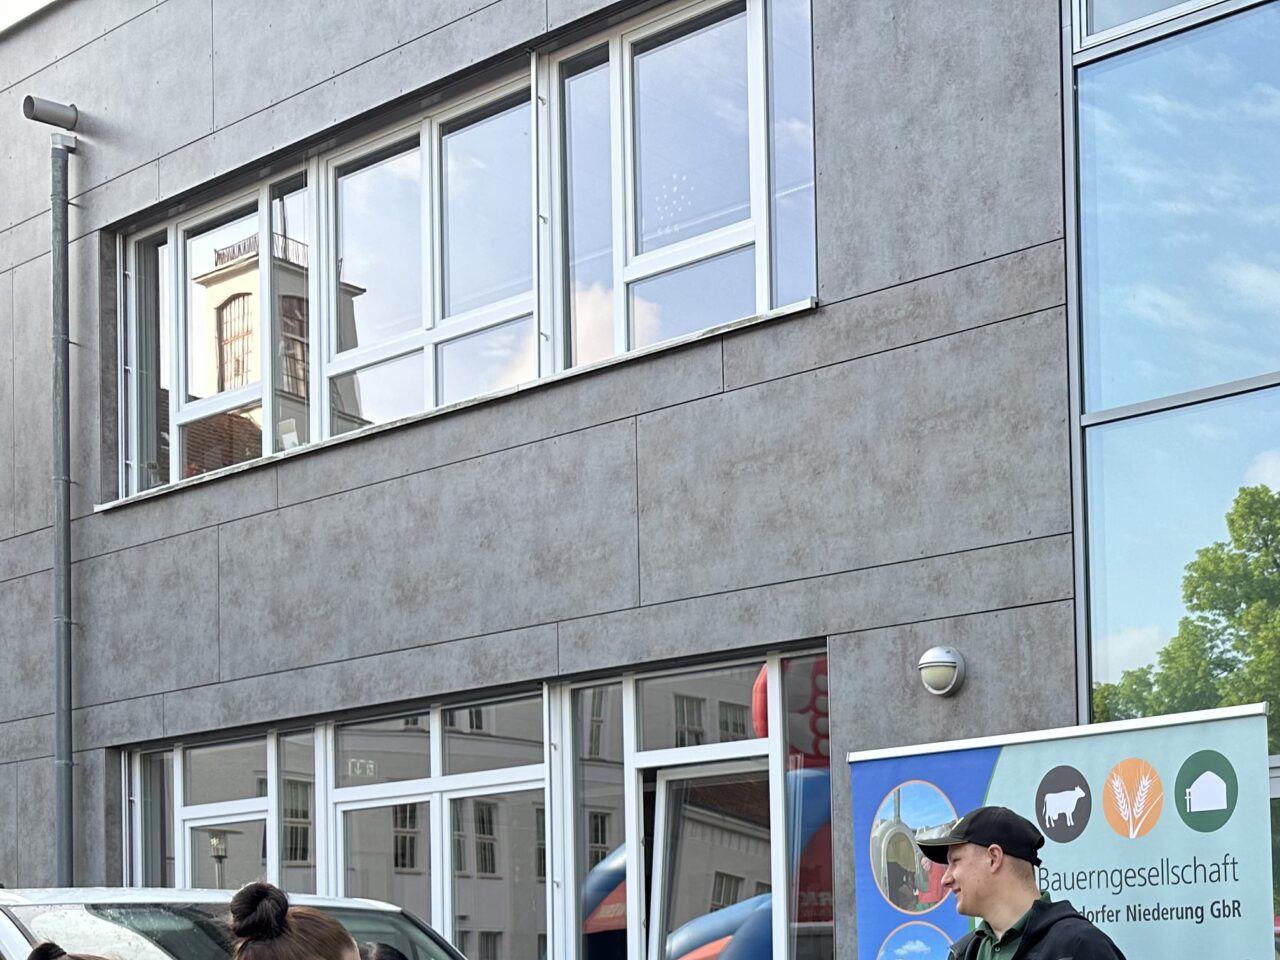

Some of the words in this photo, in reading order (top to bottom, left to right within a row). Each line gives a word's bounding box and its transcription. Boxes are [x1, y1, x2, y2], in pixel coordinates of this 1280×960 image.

[1038, 853, 1239, 895] Bauerngesellschaft
[1126, 902, 1205, 924] Niederung
[1210, 899, 1242, 918] GbR
